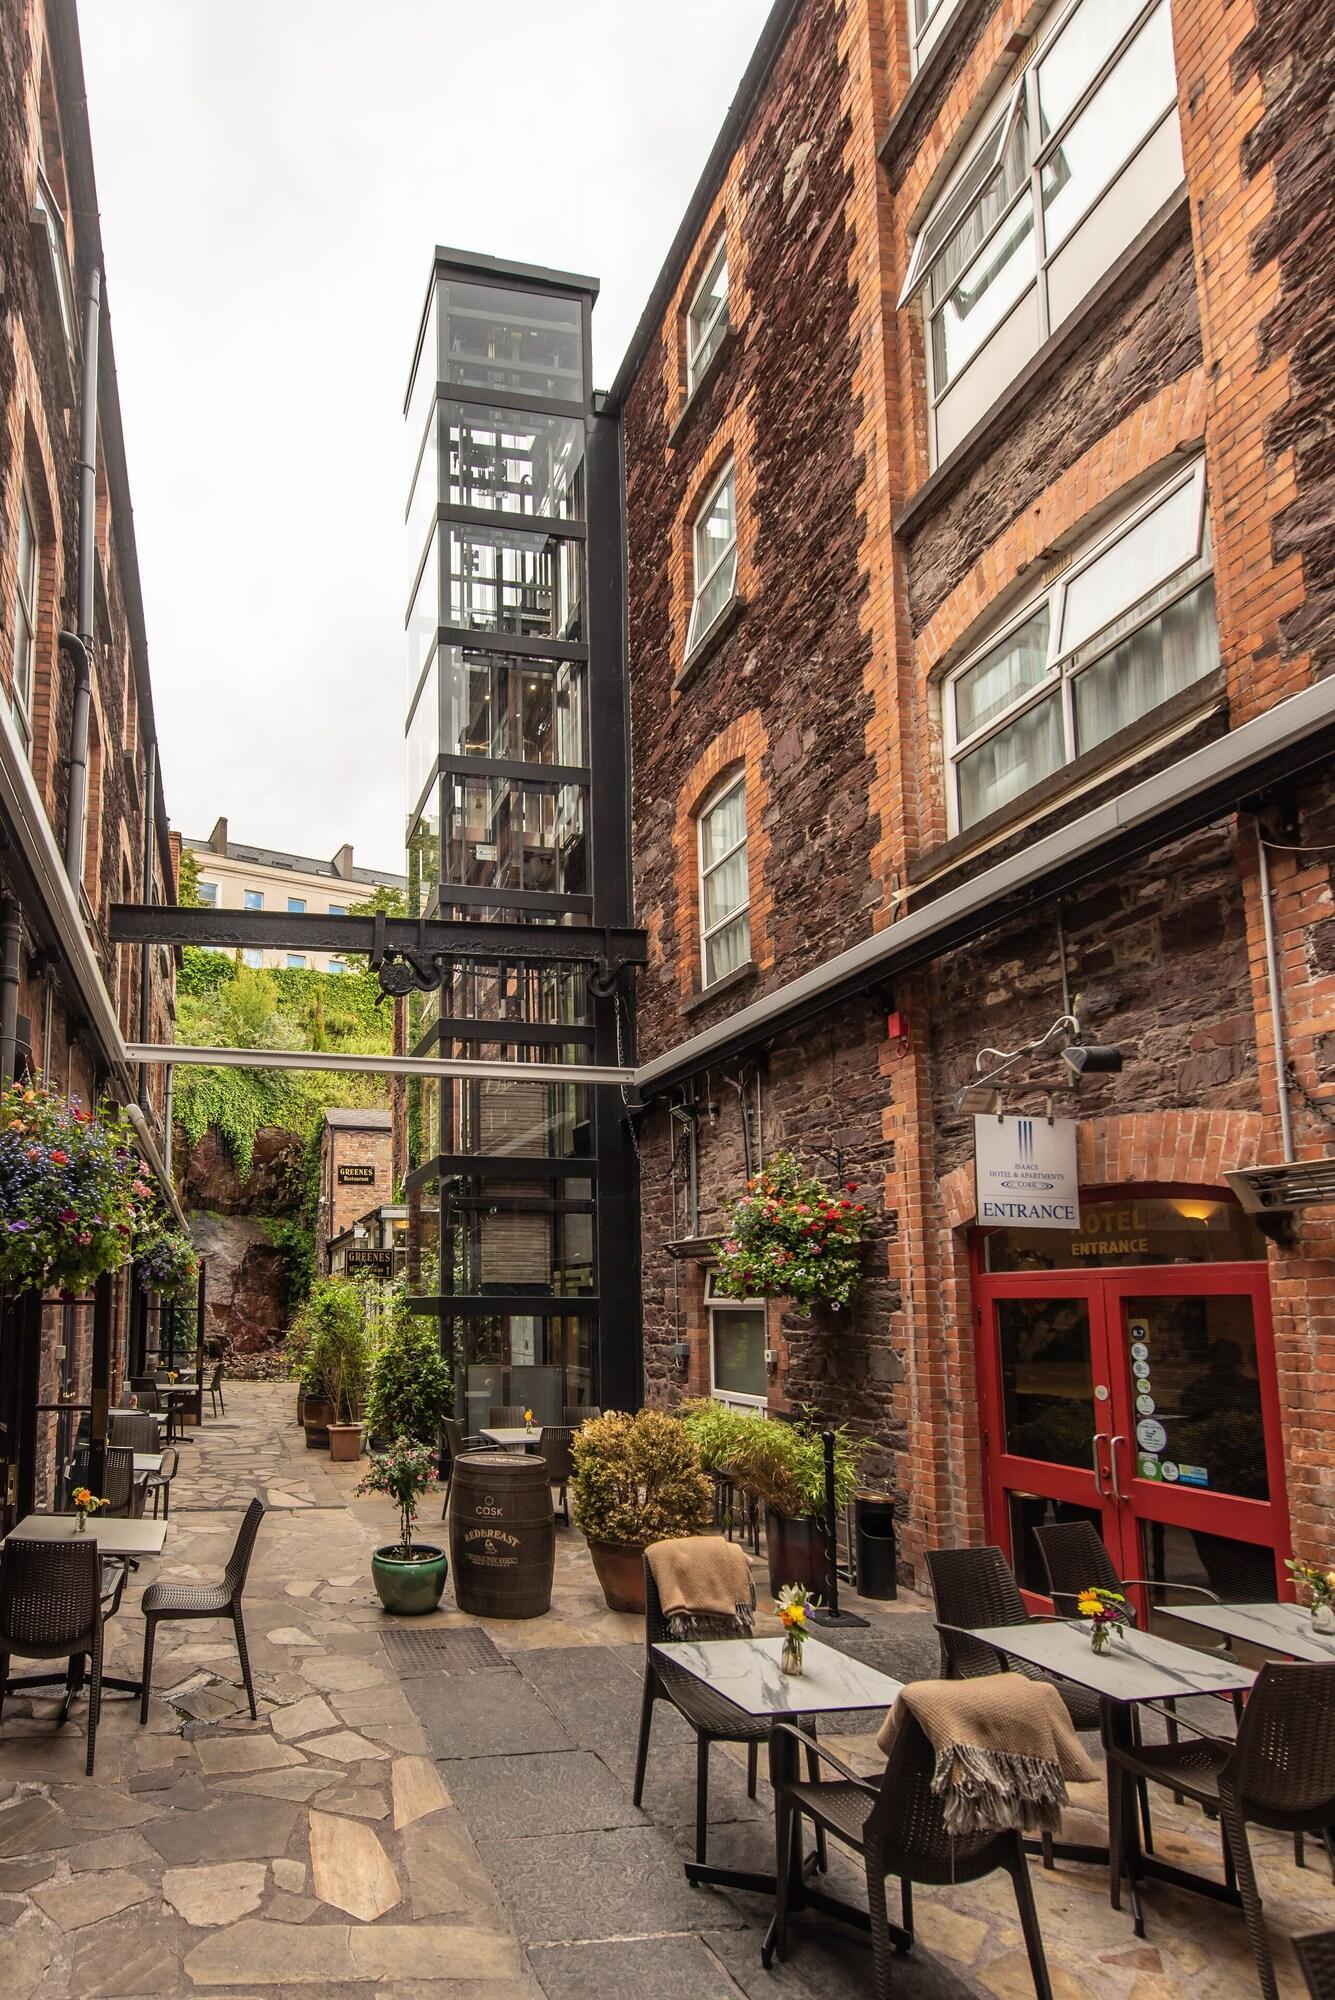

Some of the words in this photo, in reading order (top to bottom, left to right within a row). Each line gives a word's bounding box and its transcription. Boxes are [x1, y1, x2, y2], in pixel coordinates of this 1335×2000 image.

[1014, 1163, 1039, 1171] ISAACS
[1020, 1172, 1065, 1181] APARTMENTS
[983, 1202, 1075, 1220] ENTRANCE
[1071, 1239, 1148, 1256] ENTRANCE
[348, 1251, 391, 1262] GREENES
[464, 1529, 521, 1547] REDBREAST
